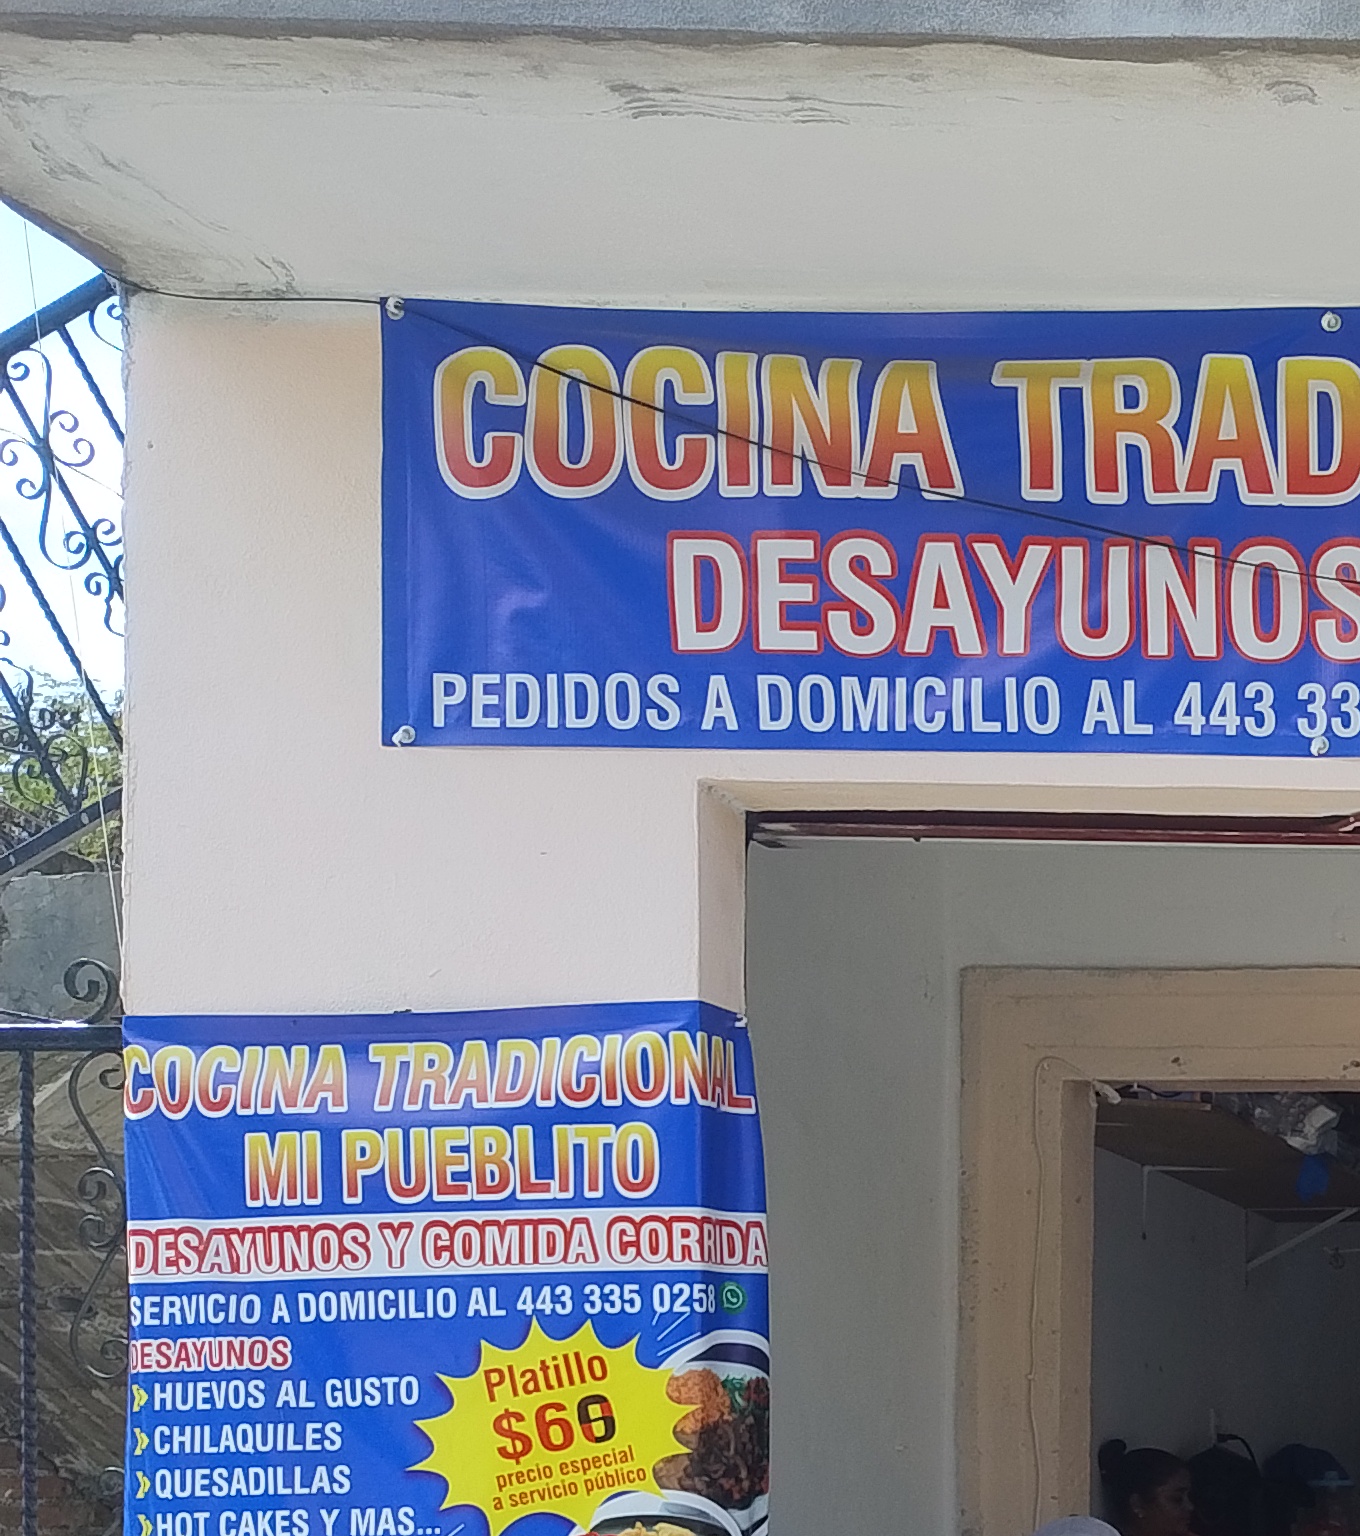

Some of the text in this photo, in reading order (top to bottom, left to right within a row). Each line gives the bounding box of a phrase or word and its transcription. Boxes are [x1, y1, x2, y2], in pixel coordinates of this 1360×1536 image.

[434, 343, 967, 500] COCINA
[431, 671, 683, 733] PEDIDOS
[700, 674, 740, 733] A
[754, 672, 1063, 735] DOMICILIO
[1081, 678, 1155, 737] AL
[1172, 678, 1277, 739] 443
[124, 1030, 756, 1120] COCINA TRADICIONAL
[244, 1122, 660, 1207] MI PUEBLITO
[129, 1215, 767, 1276] DESAYUNOS Y COMIDA CORRIDA
[131, 1282, 716, 1326] SERVICIO A DOMICILIO AL 443 335 0258
[153, 1375, 419, 1411] HUEVOS AL GUSTO
[483, 1351, 608, 1403] Platillo
[153, 1421, 343, 1455] CHILAQUILES
[154, 1465, 352, 1500] QUESADILLAS
[493, 1466, 647, 1511] a servicio público
[495, 1445, 635, 1493] precio especial
[320, 1508, 340, 1536] Y
[350, 1506, 441, 1536] MAS...
